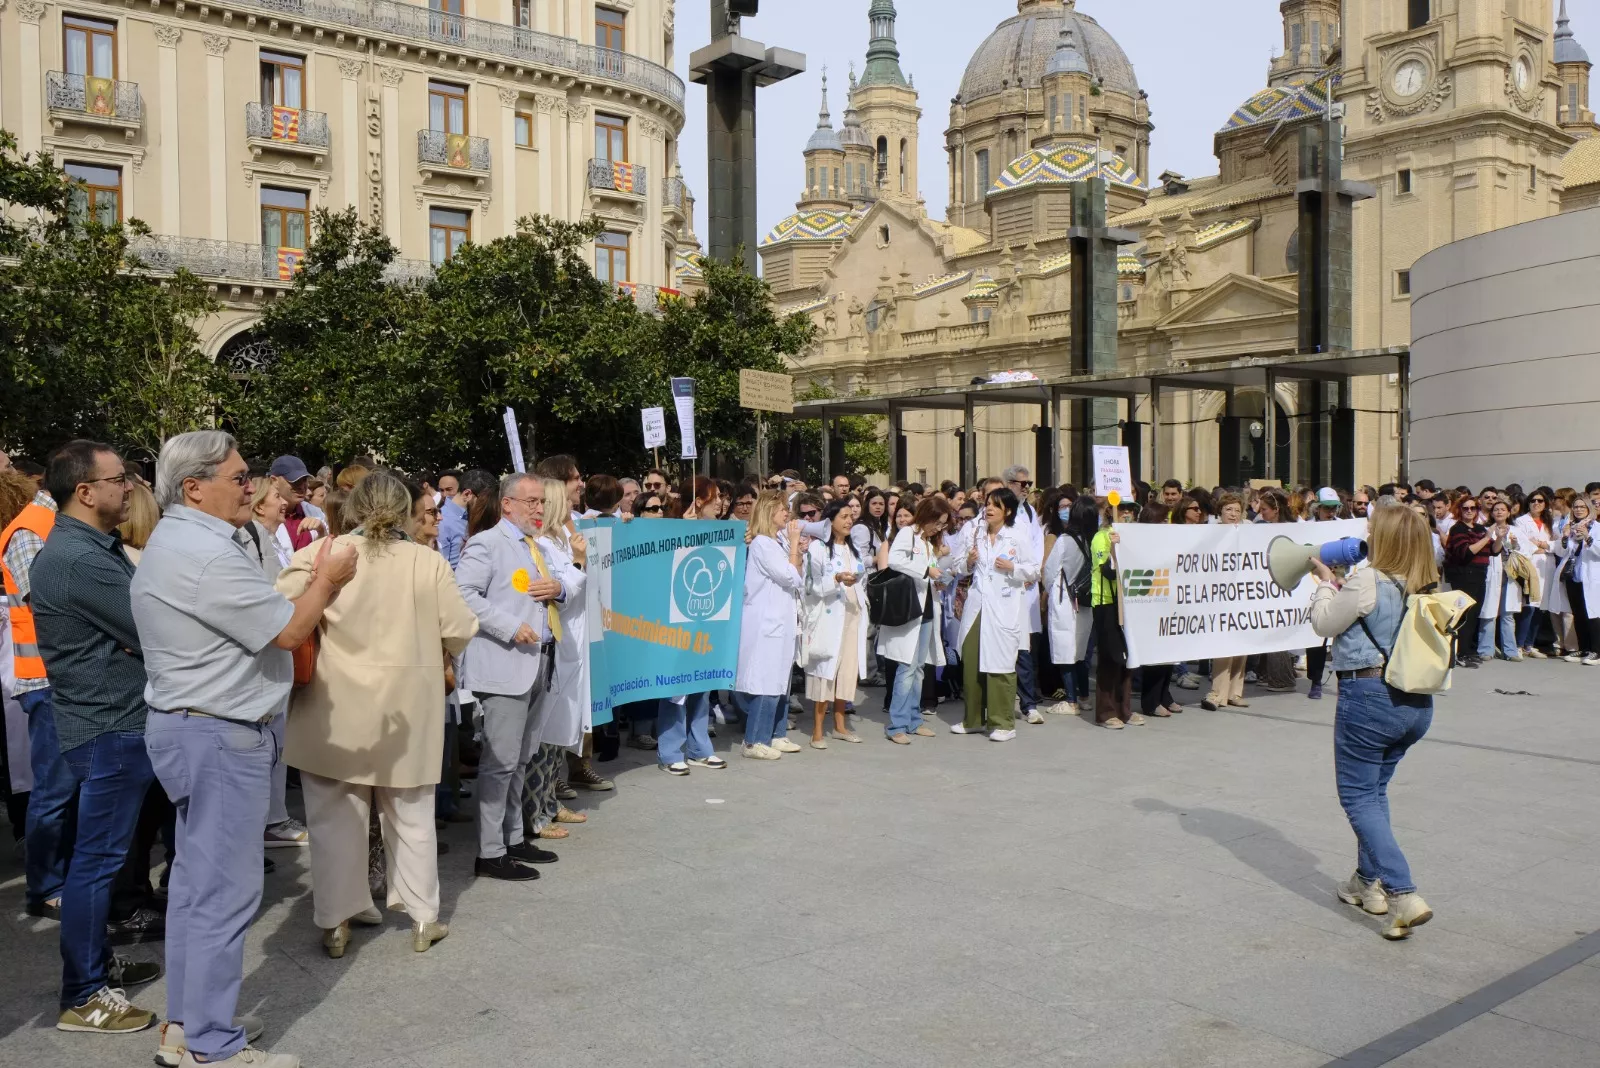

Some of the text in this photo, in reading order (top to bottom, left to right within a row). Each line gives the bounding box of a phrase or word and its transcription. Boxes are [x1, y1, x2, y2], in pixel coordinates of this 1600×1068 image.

[367, 88, 381, 217] LAS TORR
[659, 536, 682, 552] HORA
[684, 528, 735, 548] COMPUTADA
[1176, 551, 1269, 573] POR UN ESTATU
[1177, 585, 1193, 605] DE
[1194, 584, 1209, 603] LA
[602, 607, 691, 651] econocimiento
[1159, 607, 1312, 637] MÉDICA Y FACULTATIVA
[610, 668, 733, 697] egociación. Nuestro Estatuto
